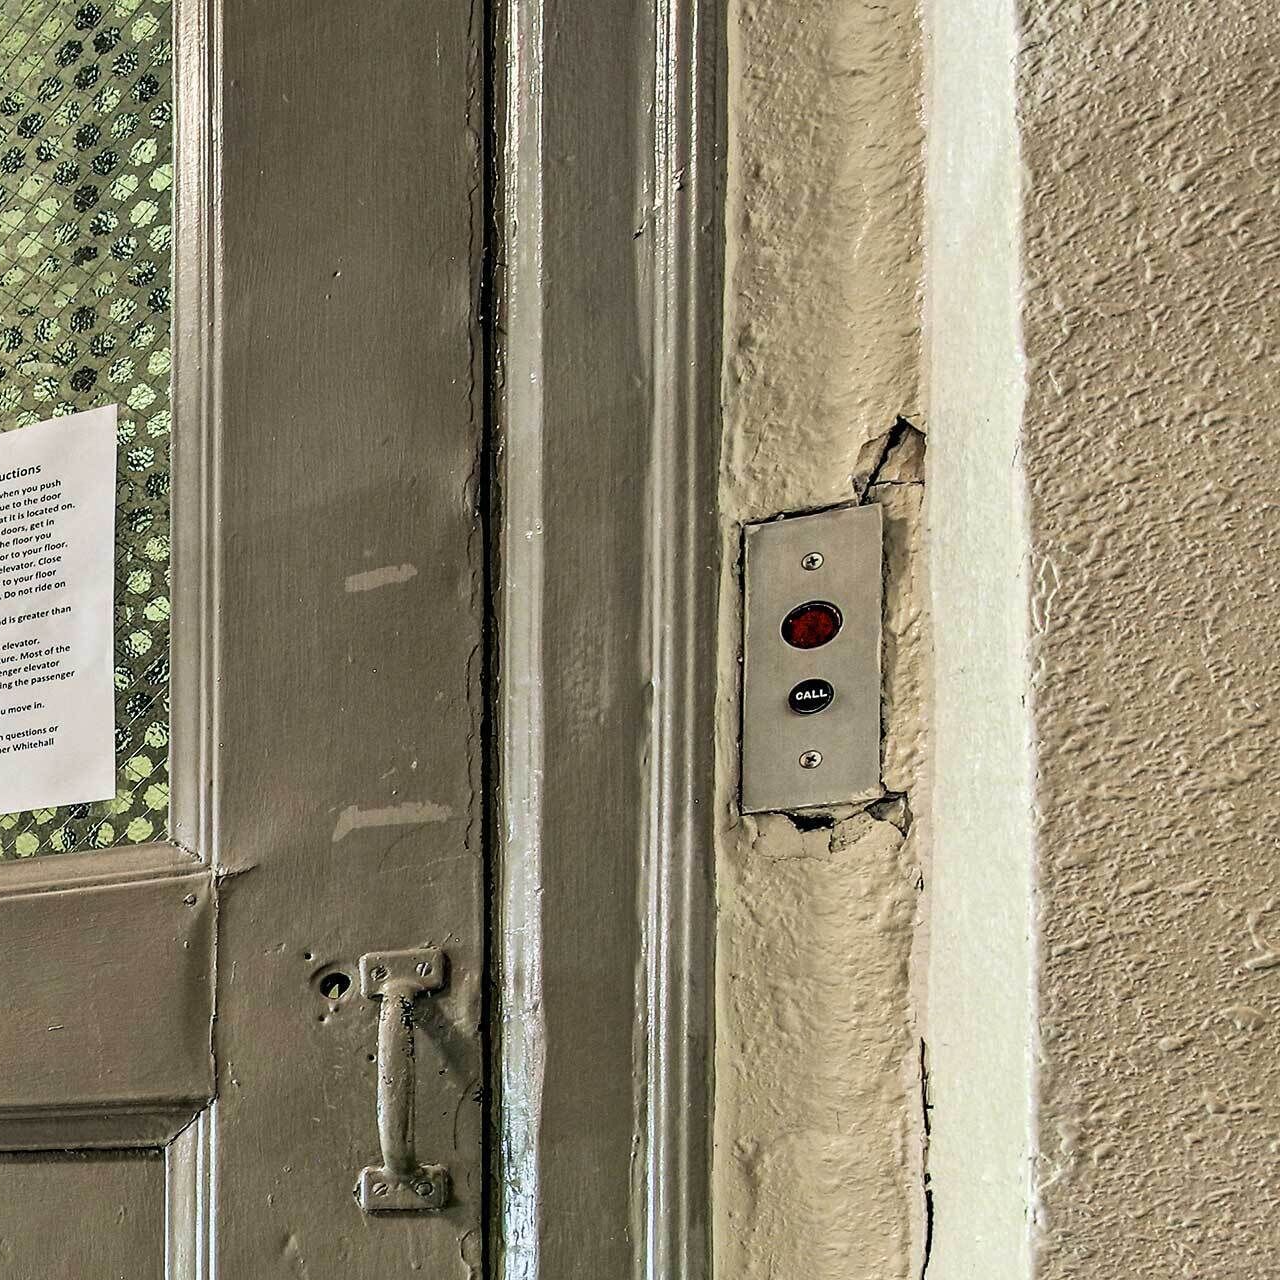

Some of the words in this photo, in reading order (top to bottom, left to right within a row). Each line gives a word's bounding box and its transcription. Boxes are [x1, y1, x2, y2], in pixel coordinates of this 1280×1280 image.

[21, 485, 37, 495] you
[39, 479, 61, 492] push
[23, 497, 38, 506] the
[40, 492, 61, 502] door
[26, 504, 59, 518] located
[0, 525, 28, 535] doors,
[30, 520, 43, 531] get
[12, 535, 33, 546] floor
[34, 532, 51, 542] you
[22, 546, 42, 558] your
[44, 541, 68, 551] floor.
[38, 555, 61, 565] Close
[13, 574, 33, 585] your
[35, 569, 56, 579] floor
[4, 591, 16, 599] Do
[18, 586, 32, 596] not
[35, 582, 52, 592] ride
[17, 610, 49, 623] greater
[51, 606, 71, 615] than
[1, 638, 40, 650] elevator.
[20, 649, 42, 660] Most
[44, 646, 54, 655] of
[55, 645, 70, 653] the
[23, 660, 59, 672] elevator
[14, 678, 28, 687] the
[31, 670, 75, 685] passenger
[795, 689, 828, 701] CALL
[8, 704, 32, 714] move
[33, 701, 44, 709] in.
[5, 727, 47, 741] questions
[12, 737, 54, 751] Whitehall
